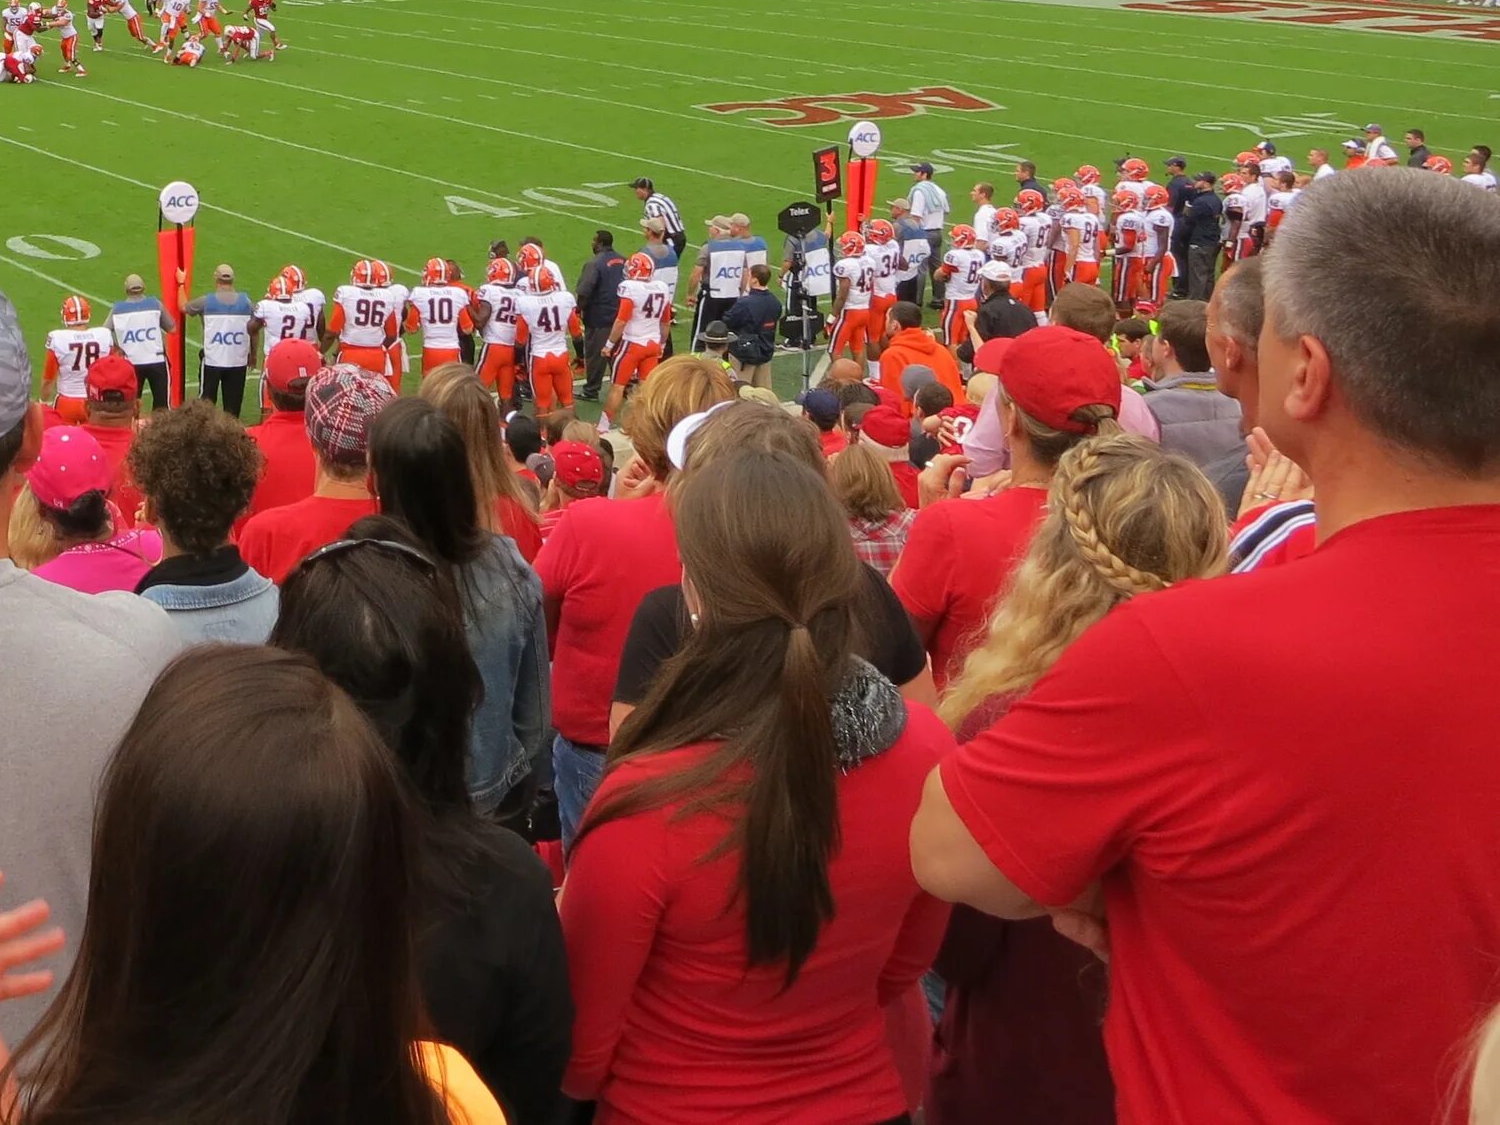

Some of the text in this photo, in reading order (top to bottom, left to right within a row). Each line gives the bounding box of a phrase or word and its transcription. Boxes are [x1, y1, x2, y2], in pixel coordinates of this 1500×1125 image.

[855, 132, 877, 143] ACC
[820, 151, 837, 182] 3
[166, 195, 195, 208] ACC
[789, 206, 811, 217] Telex
[1082, 222, 1099, 244] 84
[716, 266, 742, 279] ACC
[806, 262, 831, 277] ACC
[880, 253, 899, 278] 34
[855, 267, 874, 293] 43
[354, 299, 386, 326] 96
[427, 298, 451, 325] 10
[642, 293, 665, 319] 47
[537, 305, 562, 332] 41
[123, 328, 157, 344] ACC
[211, 331, 244, 346] ACC
[69, 341, 101, 371] 78
